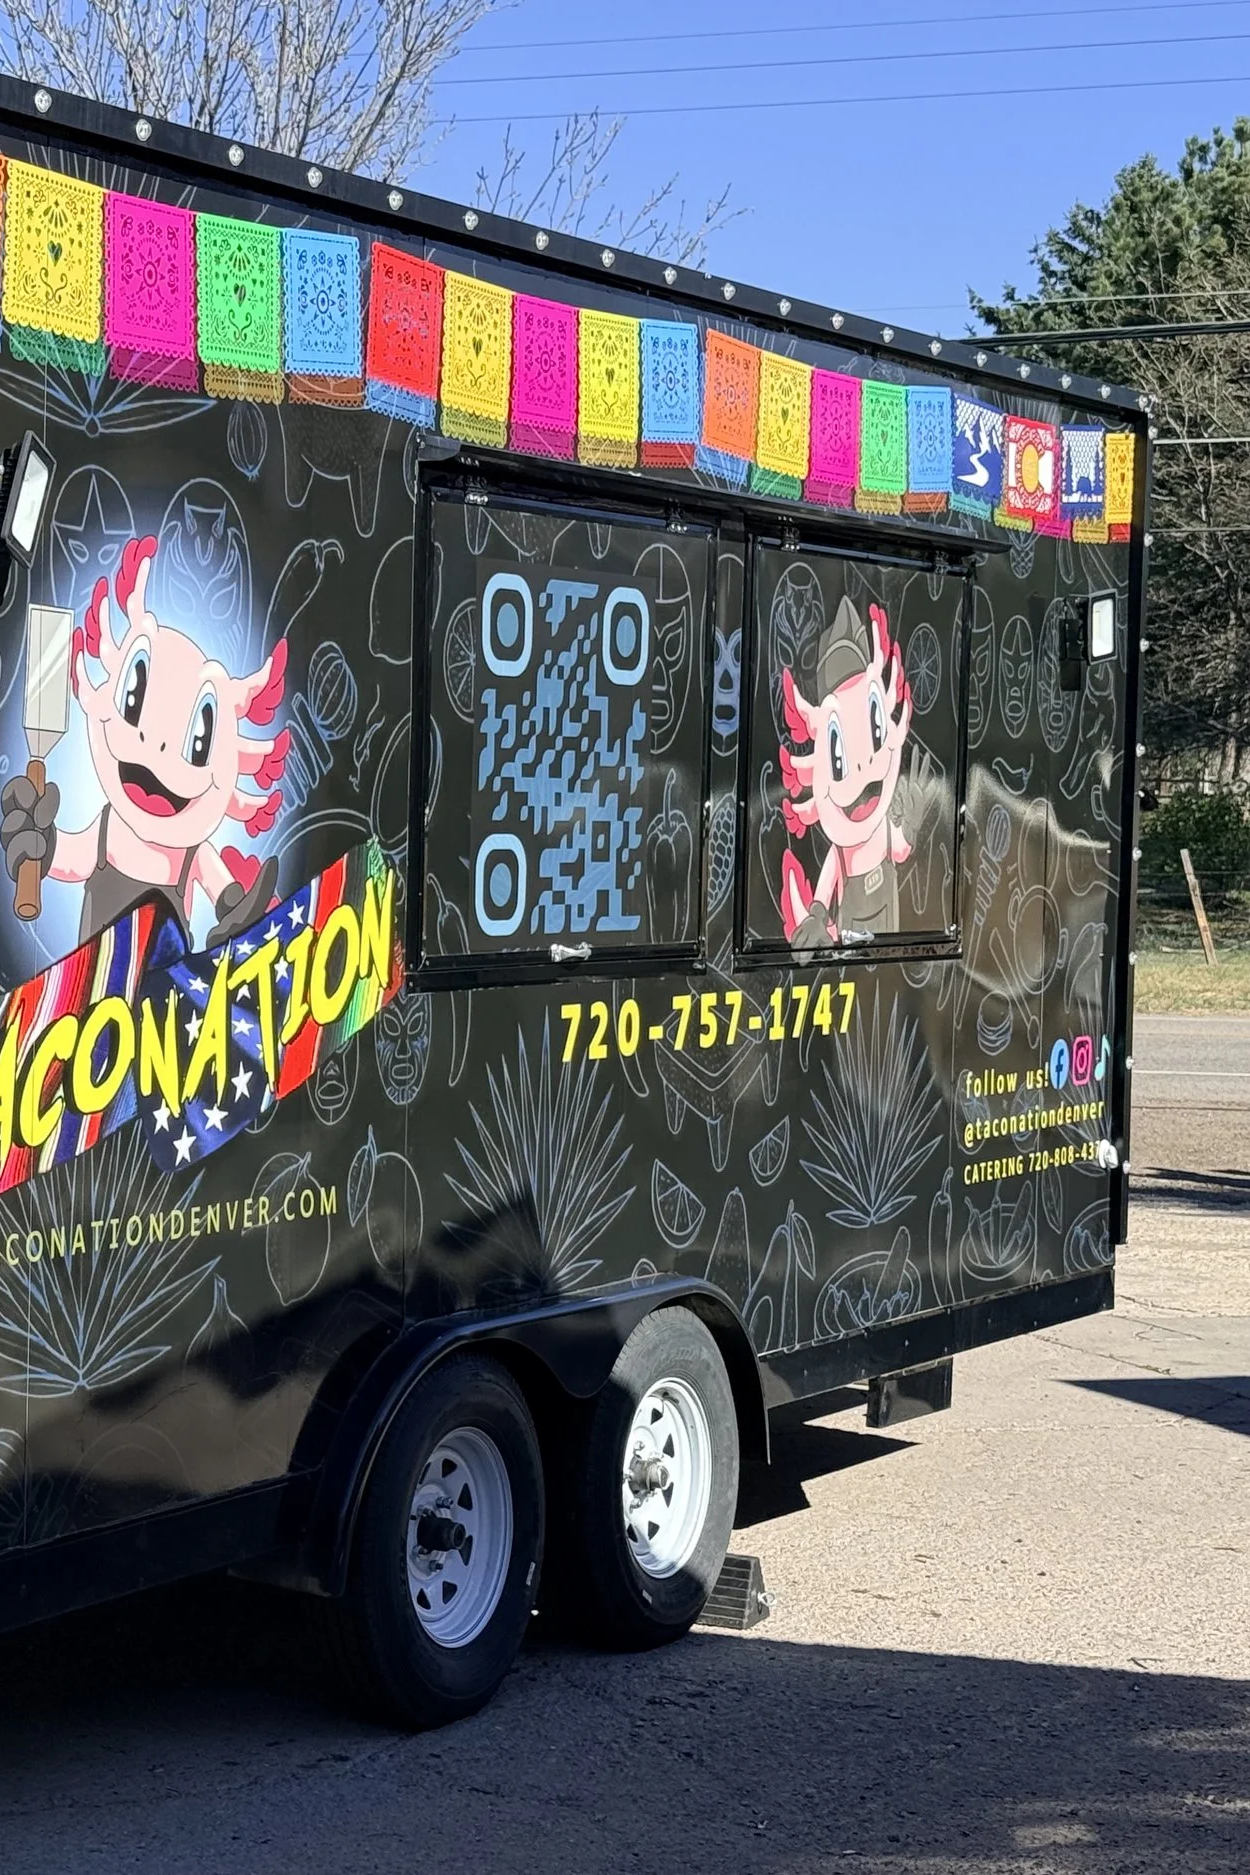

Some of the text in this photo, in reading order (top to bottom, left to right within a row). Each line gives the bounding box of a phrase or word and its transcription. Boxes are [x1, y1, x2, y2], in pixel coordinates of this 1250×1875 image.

[561, 982, 856, 1063] 720-757-1747
[965, 1061, 1049, 1099] follow us!
[964, 1100, 1105, 1148] @taconationdenver
[964, 1140, 1101, 1185] CATERING 720-808-437
